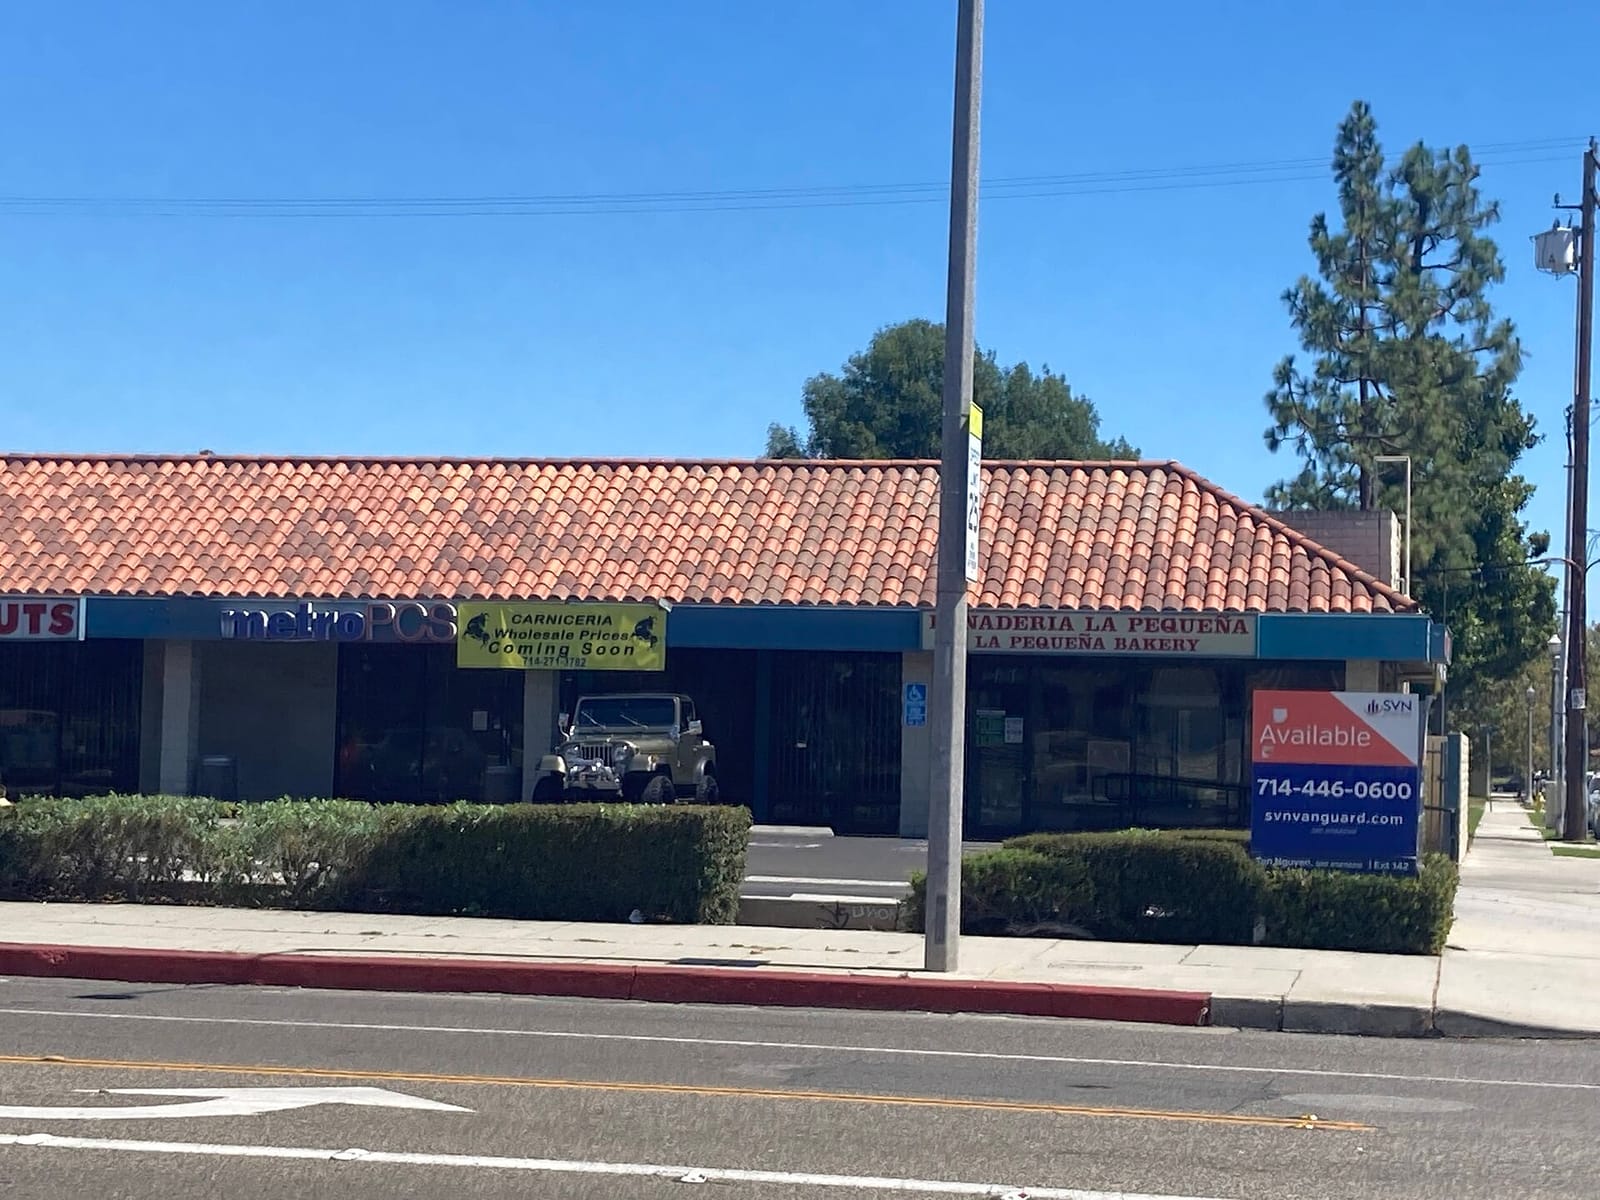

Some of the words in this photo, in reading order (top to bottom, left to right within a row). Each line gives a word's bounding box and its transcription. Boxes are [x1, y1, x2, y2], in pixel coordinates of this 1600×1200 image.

[0, 603, 75, 635] UTS
[220, 602, 458, 641] metroPCS
[511, 614, 613, 625] CARNICERIA
[929, 614, 1075, 632] NADERIA
[1085, 616, 1117, 633] LA
[1128, 614, 1249, 634] PEQUEÑA
[494, 629, 575, 641] Wholesale
[579, 630, 628, 641] Prices
[975, 635, 1001, 649] LA
[1010, 633, 1105, 650] PEQUEÑA
[1114, 637, 1200, 652] BAKERY
[488, 641, 569, 658] Coming
[581, 642, 635, 656] Soon
[1383, 699, 1412, 712] SVN
[1260, 724, 1371, 746] Available
[1257, 778, 1412, 800] 714-446-0600
[1264, 810, 1404, 826] svnvanguard.com
